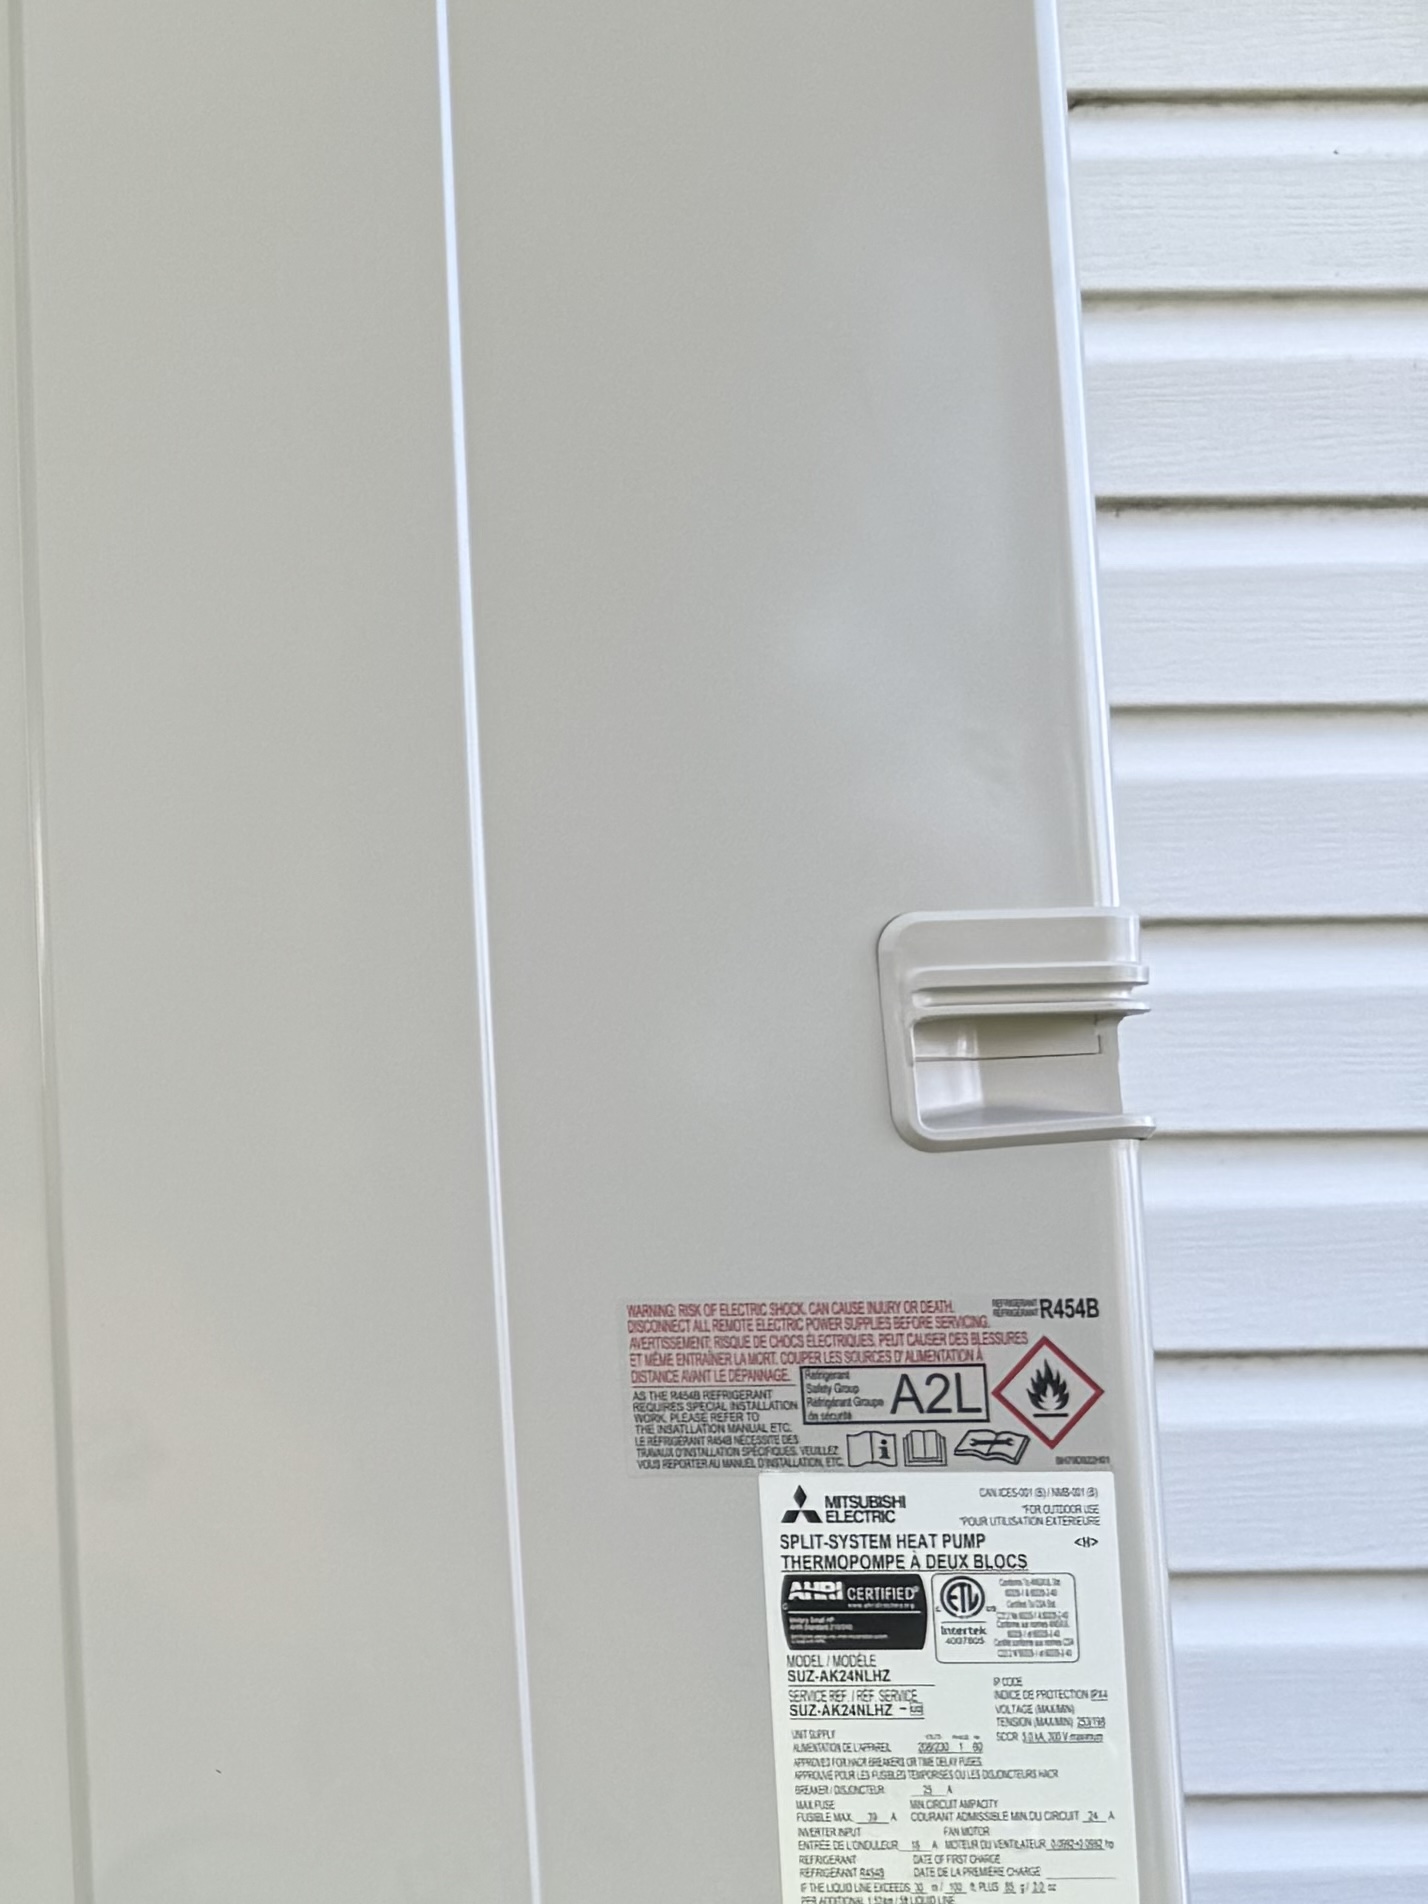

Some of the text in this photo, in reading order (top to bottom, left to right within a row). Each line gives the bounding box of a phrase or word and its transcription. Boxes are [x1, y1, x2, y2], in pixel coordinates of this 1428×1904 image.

[678, 1303, 702, 1317] RISK
[704, 1303, 717, 1316] OF
[719, 1302, 767, 1316] ELECTRIC
[808, 1302, 829, 1315] CAN
[831, 1301, 865, 1315] CAUSE
[867, 1300, 901, 1314] INJURY
[903, 1300, 918, 1314] OR
[1040, 1298, 1100, 1319] R454B
[627, 1319, 691, 1333] DISCONNECT
[693, 1319, 711, 1333] ALL
[712, 1318, 754, 1332] REMOTE
[756, 1318, 804, 1332] ELECTRIC
[806, 1317, 843, 1331] POWER
[844, 1316, 891, 1330] SUPPLIES
[893, 1316, 933, 1330] BEFORE
[713, 1335, 751, 1349] RISQUE
[753, 1335, 767, 1349] DE
[769, 1335, 804, 1349] CHOCS
[878, 1333, 904, 1347] PEUT
[906, 1332, 946, 1346] CAUSER
[948, 1332, 969, 1346] DES
[971, 1331, 1028, 1346] BLESSURES
[632, 1391, 646, 1401] AS
[649, 1391, 668, 1401] THE
[703, 1389, 773, 1400] REFRIGERANT
[834, 1383, 860, 1394] Group
[890, 1372, 983, 1415] A2L
[633, 1400, 798, 1412] REQUIRES SPECIAL INSTALLATION
[670, 1412, 708, 1423] PLEASE
[710, 1412, 744, 1423] REFER
[747, 1412, 760, 1422] TO
[635, 1424, 655, 1435] THE
[727, 1423, 768, 1433] MANUAL
[824, 1495, 906, 1509] MITSUBISHI
[825, 1510, 896, 1524] ELECTRIC
[780, 1533, 986, 1550] SPLIT-SYSTEM HEAT PUMP
[780, 1550, 1028, 1570] THERMOPOMPE À DEUX BLOCS
[788, 1581, 844, 1601] AHRI
[941, 1626, 987, 1636] Intertek
[786, 1654, 824, 1668] MODEL
[787, 1669, 891, 1682] SUZ-AK24NLHZ
[788, 1689, 827, 1702] SERVICE
[878, 1688, 918, 1702] SERVICE
[789, 1704, 893, 1717] SUZ-AK24NLHZ
